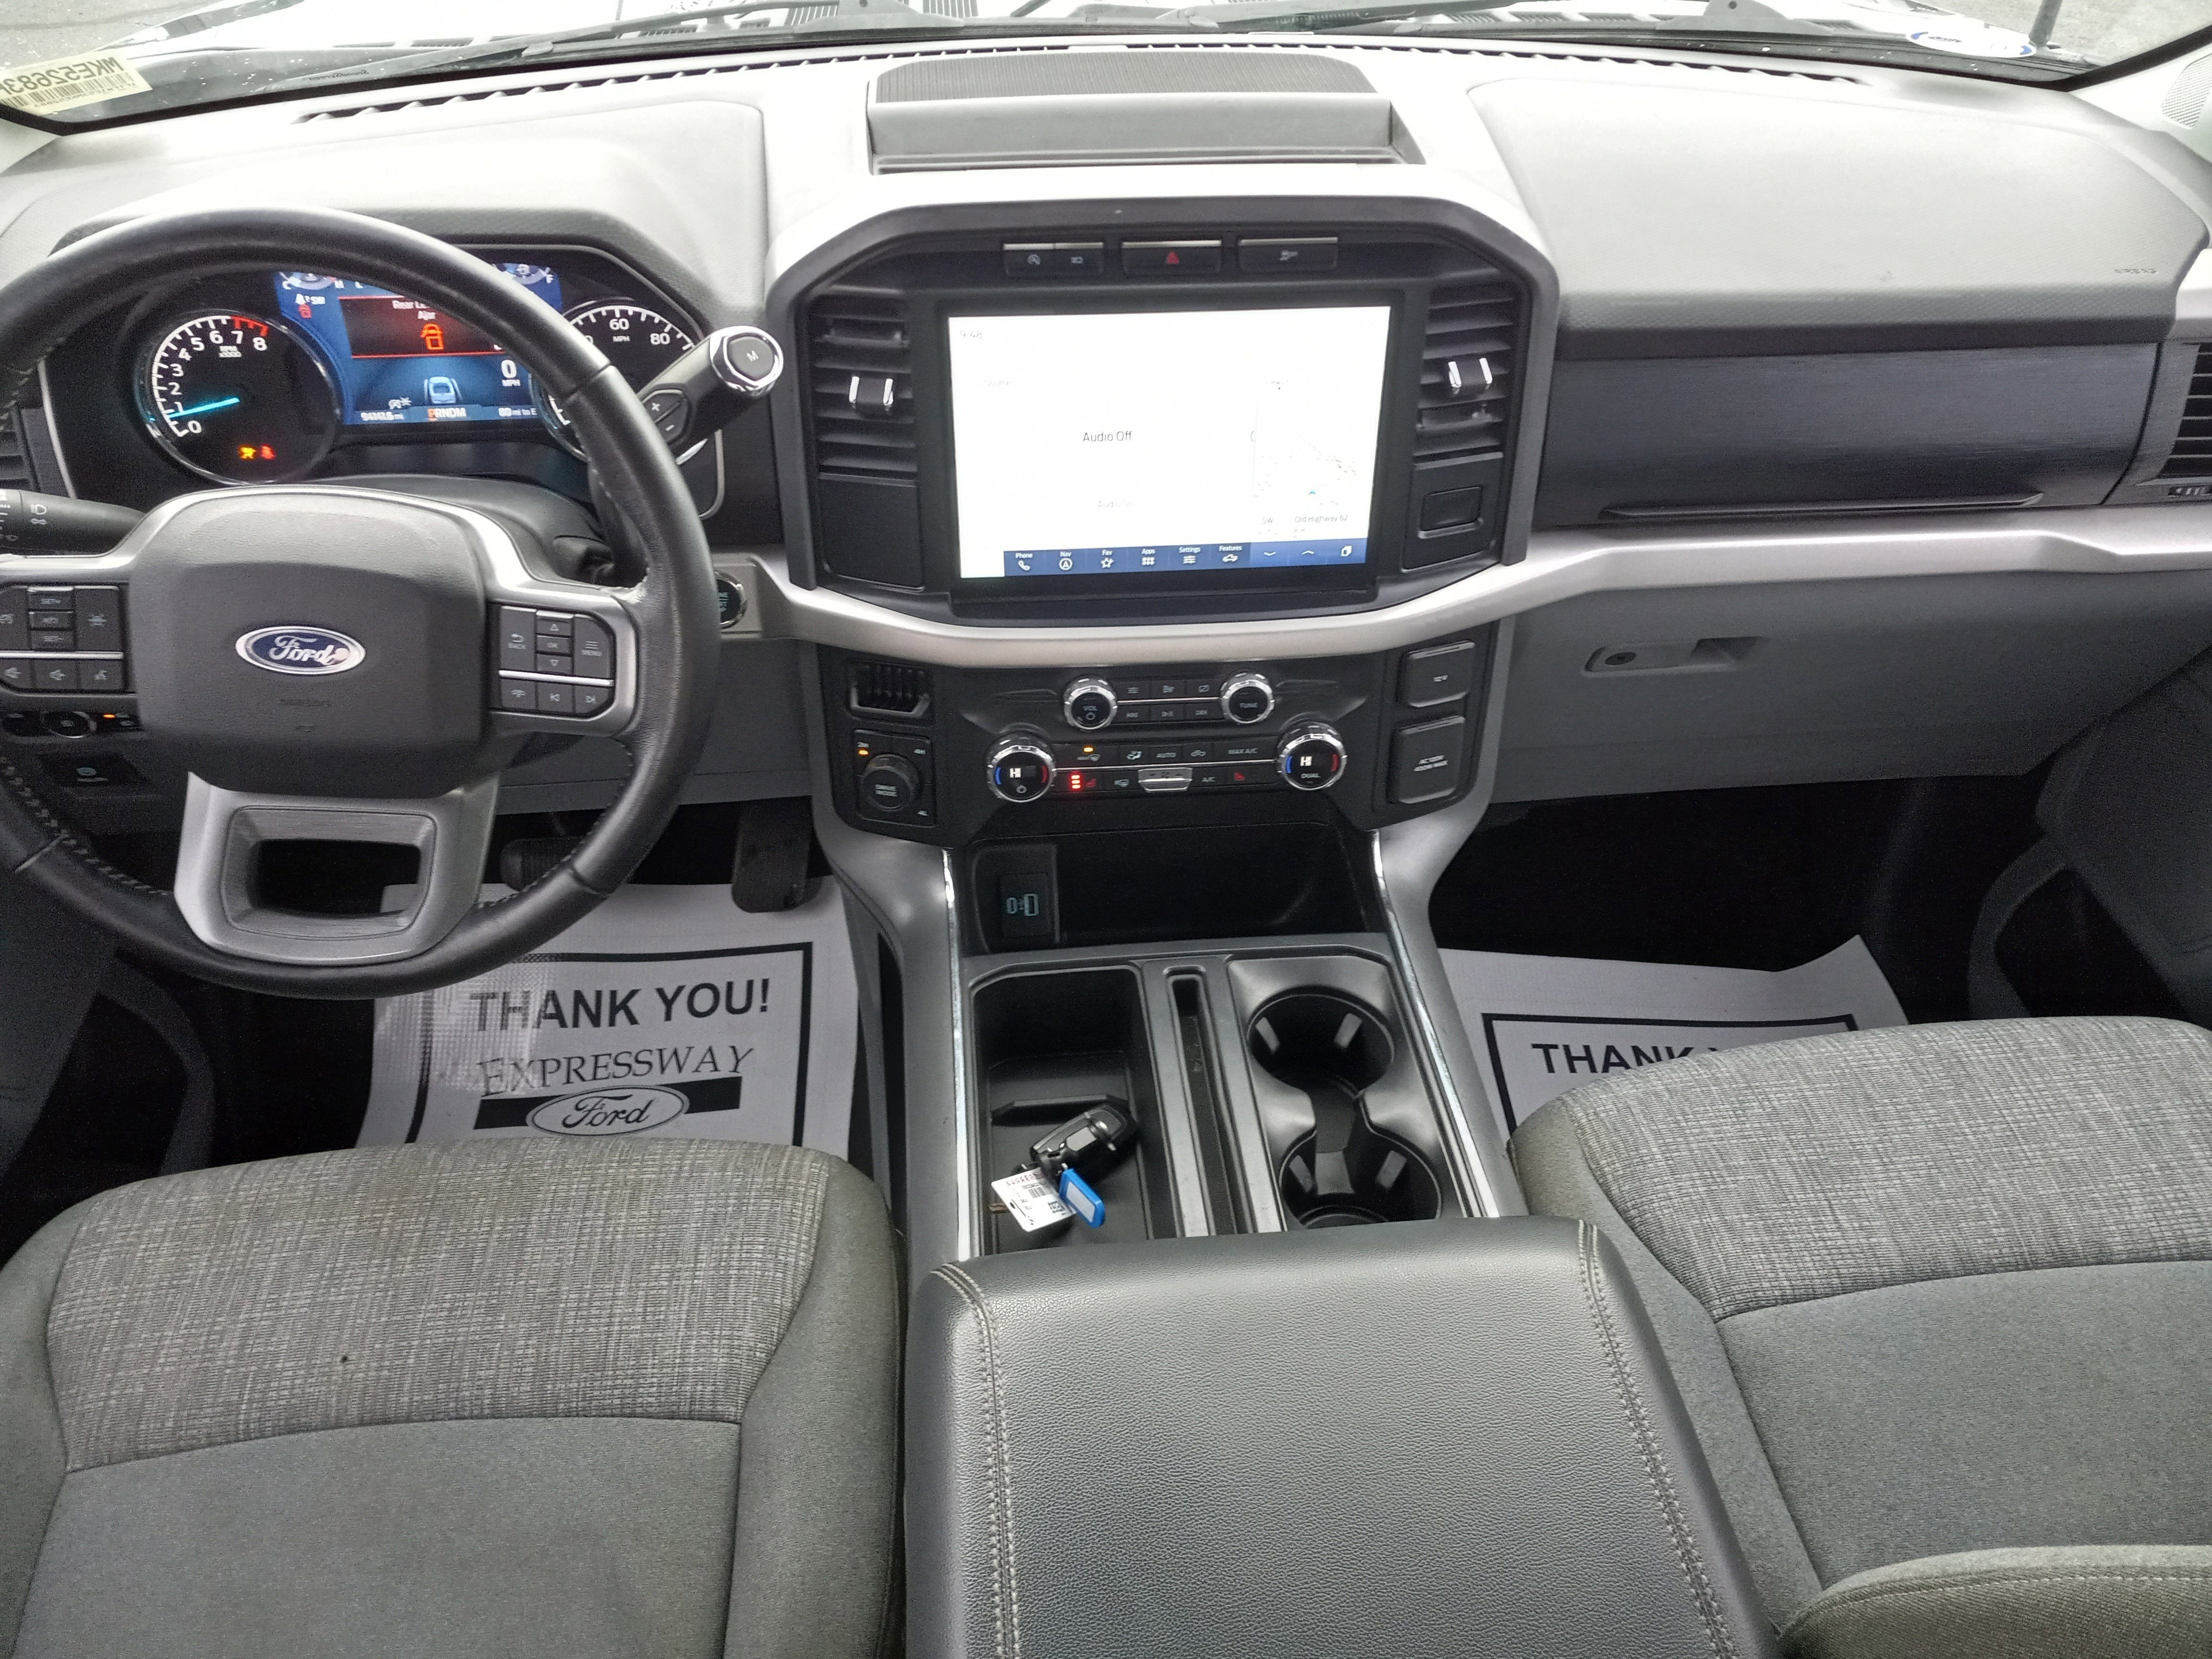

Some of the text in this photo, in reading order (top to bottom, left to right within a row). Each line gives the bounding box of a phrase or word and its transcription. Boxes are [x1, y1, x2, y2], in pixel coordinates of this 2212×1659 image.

[609, 318, 629, 330] 60
[191, 337, 205, 350] 5
[209, 330, 223, 344] 6
[231, 331, 243, 344] 7
[650, 333, 670, 345] 80
[253, 337, 267, 351] 8
[179, 348, 192, 361] 4
[746, 350, 759, 362] M
[170, 363, 184, 376] 3
[501, 360, 517, 378] 0
[168, 382, 182, 395] 2
[174, 402, 184, 413] 1
[188, 421, 202, 433] 0
[1083, 431, 1132, 442] Audio Off
[269, 635, 338, 666] Ford
[470, 978, 770, 1032] THANK YOU!
[477, 1045, 754, 1097] EXPRESSWAY
[562, 1094, 657, 1130] Ford
